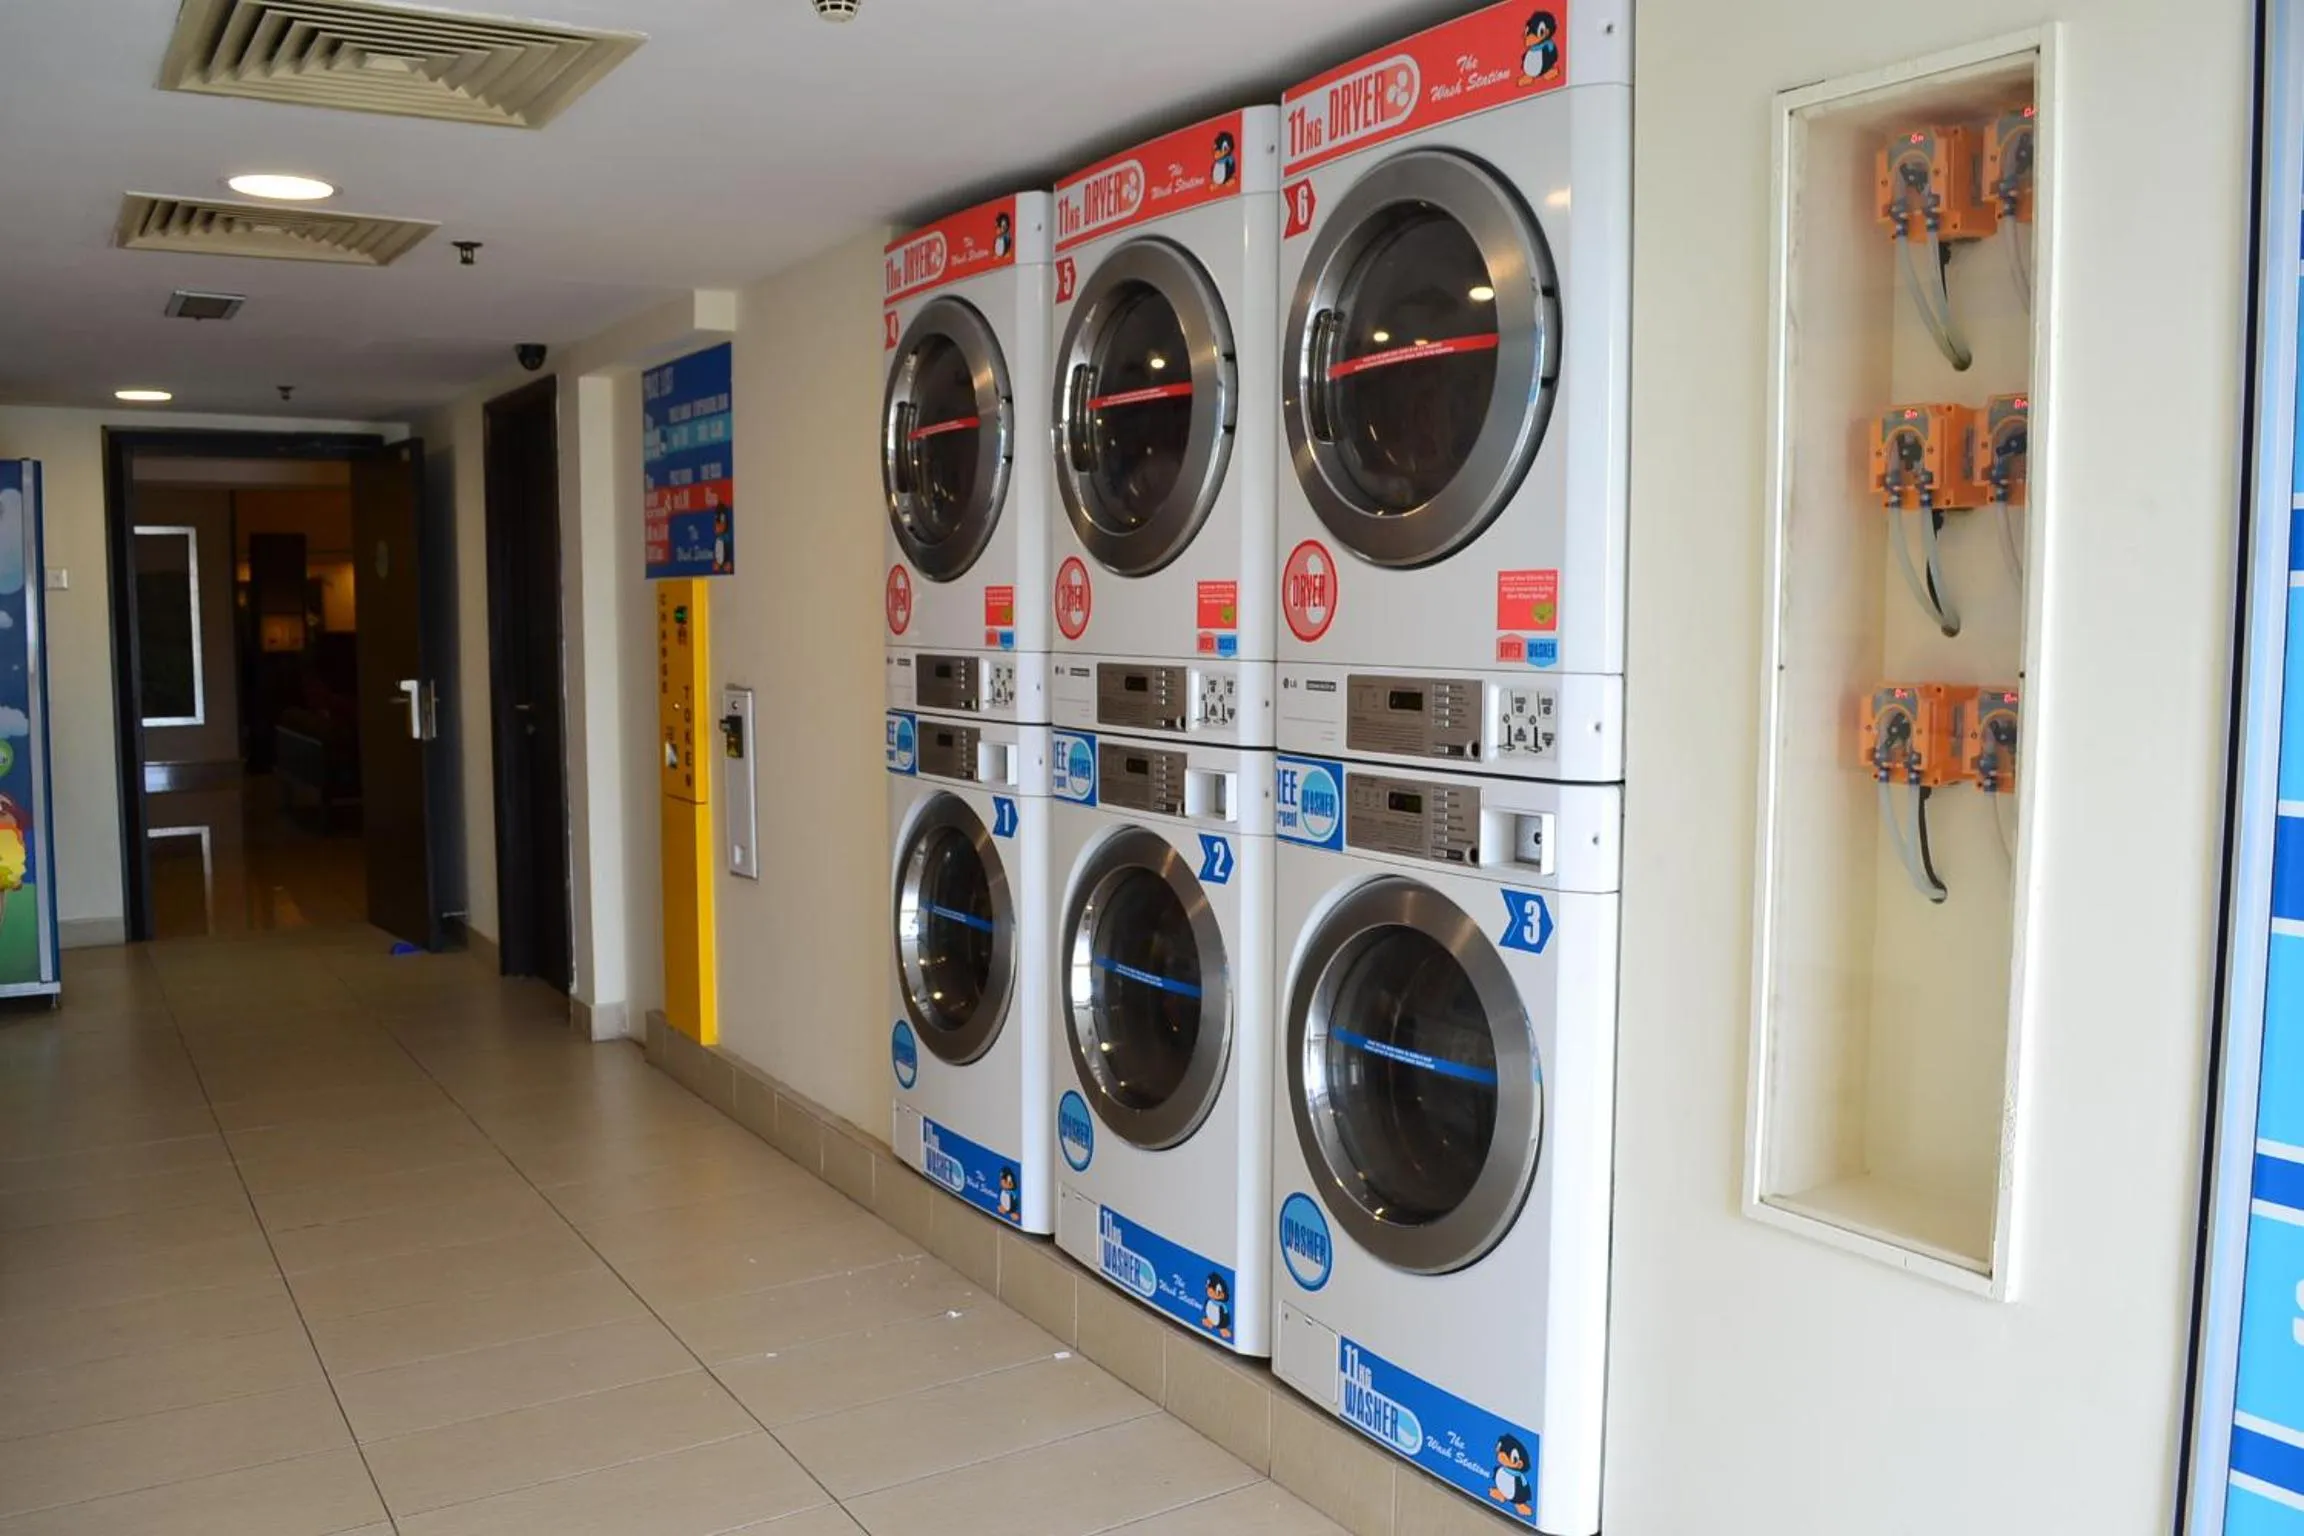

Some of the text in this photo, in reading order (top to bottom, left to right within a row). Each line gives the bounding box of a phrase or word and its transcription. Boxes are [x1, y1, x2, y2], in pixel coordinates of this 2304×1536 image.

[1457, 54, 1478, 72] The
[1329, 69, 1385, 141] DRYER
[1430, 67, 1510, 104] Wash Station
[1084, 171, 1122, 226] DRYER
[1297, 185, 1308, 226] 6
[1063, 261, 1072, 296] 5
[1293, 574, 1325, 608] DRYER
[1002, 802, 1010, 833] 1
[1213, 841, 1226, 877] 2
[1523, 900, 1541, 945] 3
[1284, 1215, 1328, 1268] WASHER
[1103, 1239, 1141, 1288] WASHER
[1344, 1379, 1398, 1443] WASHER
[1426, 1436, 1491, 1479] Wash Station
[1447, 1429, 1466, 1450] The
